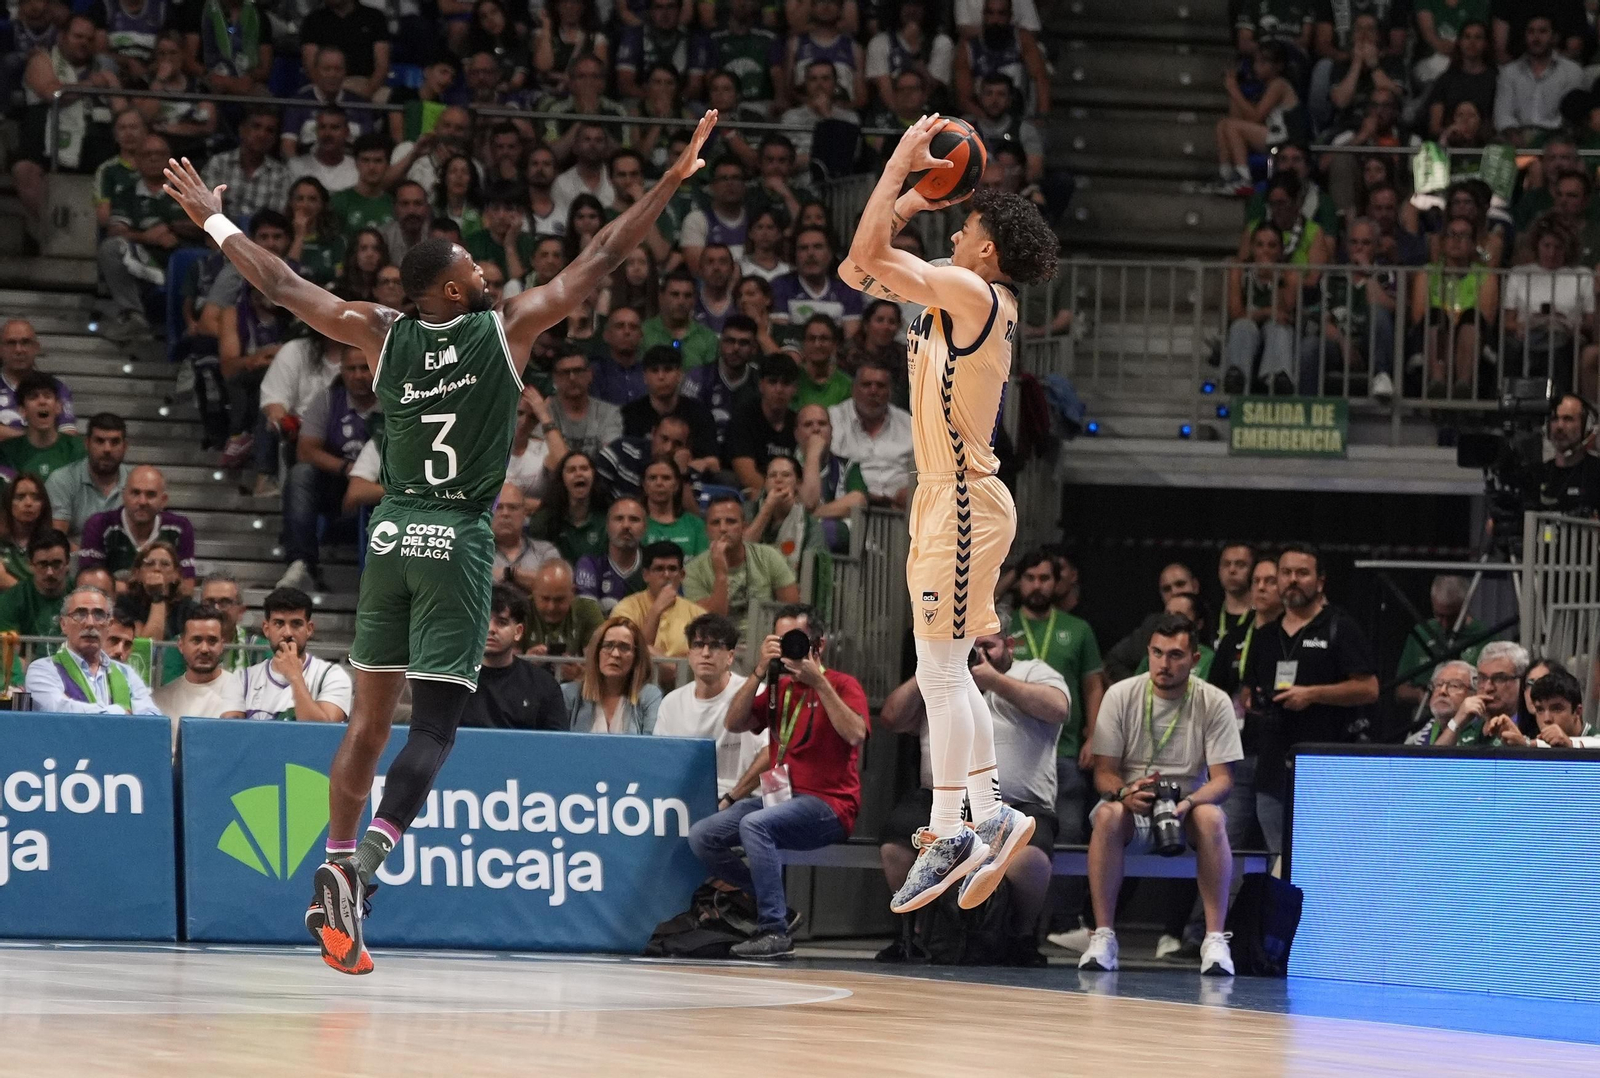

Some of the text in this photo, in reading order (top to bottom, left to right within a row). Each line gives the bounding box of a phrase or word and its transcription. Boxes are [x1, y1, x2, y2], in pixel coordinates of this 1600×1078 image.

[1242, 402, 1335, 427] SALIDA DE
[420, 413, 457, 485] 3
[1232, 427, 1342, 452] EMERGENCIA
[402, 536, 453, 550] DEL SOL
[405, 523, 456, 540] COSTA
[400, 547, 450, 561] MÁLAGA
[0, 758, 143, 814] ción
[372, 833, 603, 906] Unicaja
